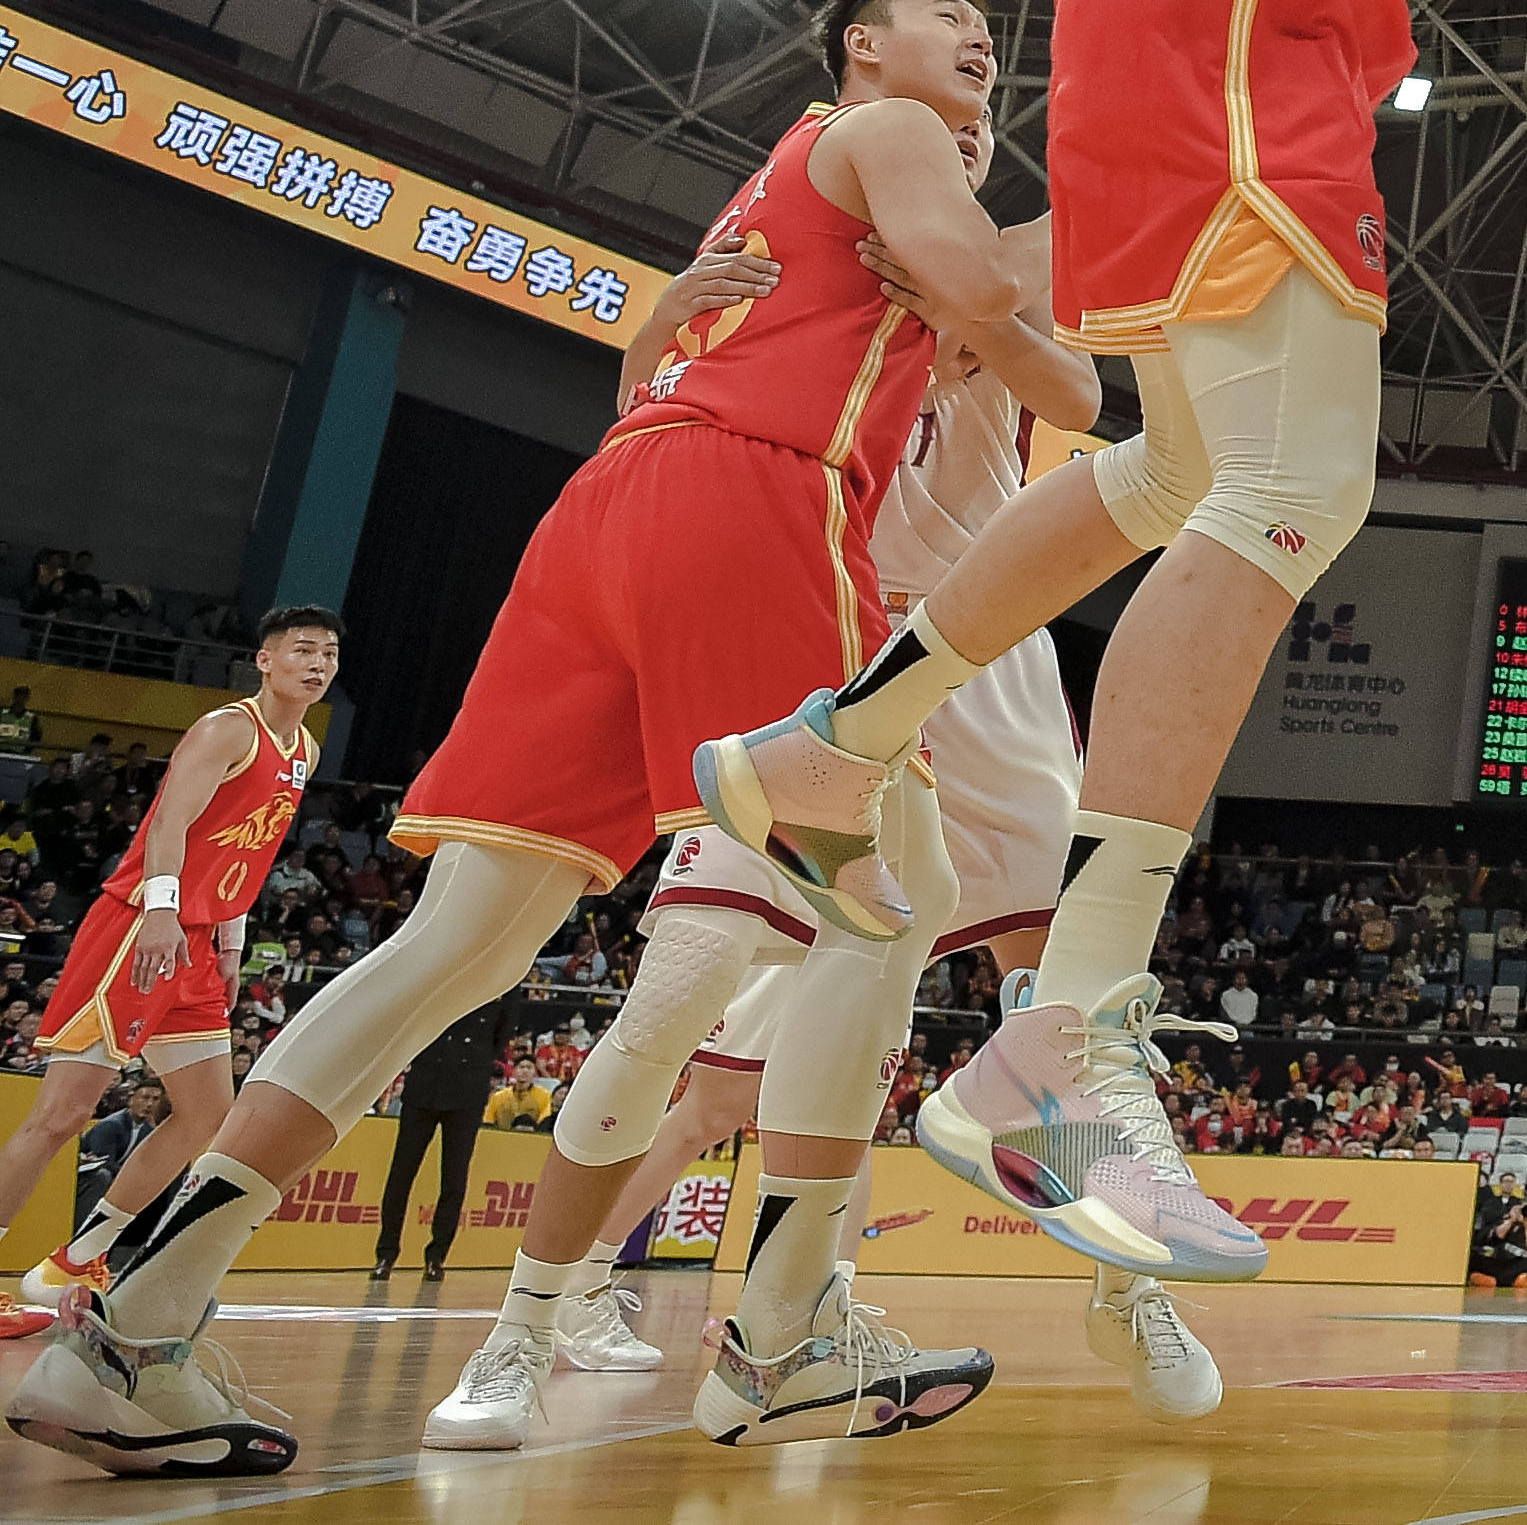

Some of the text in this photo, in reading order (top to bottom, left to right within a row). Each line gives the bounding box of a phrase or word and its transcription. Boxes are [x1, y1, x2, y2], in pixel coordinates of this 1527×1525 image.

[155, 101, 395, 233] 顽强拼搏
[414, 205, 631, 326] 奋勇争先
[1279, 714, 1400, 737] Sports Centre
[1283, 694, 1383, 717] Huanglong
[217, 860, 248, 902] 0
[276, 1170, 363, 1224] DHL
[484, 1180, 536, 1228] DH
[1205, 1197, 1357, 1242] HL
